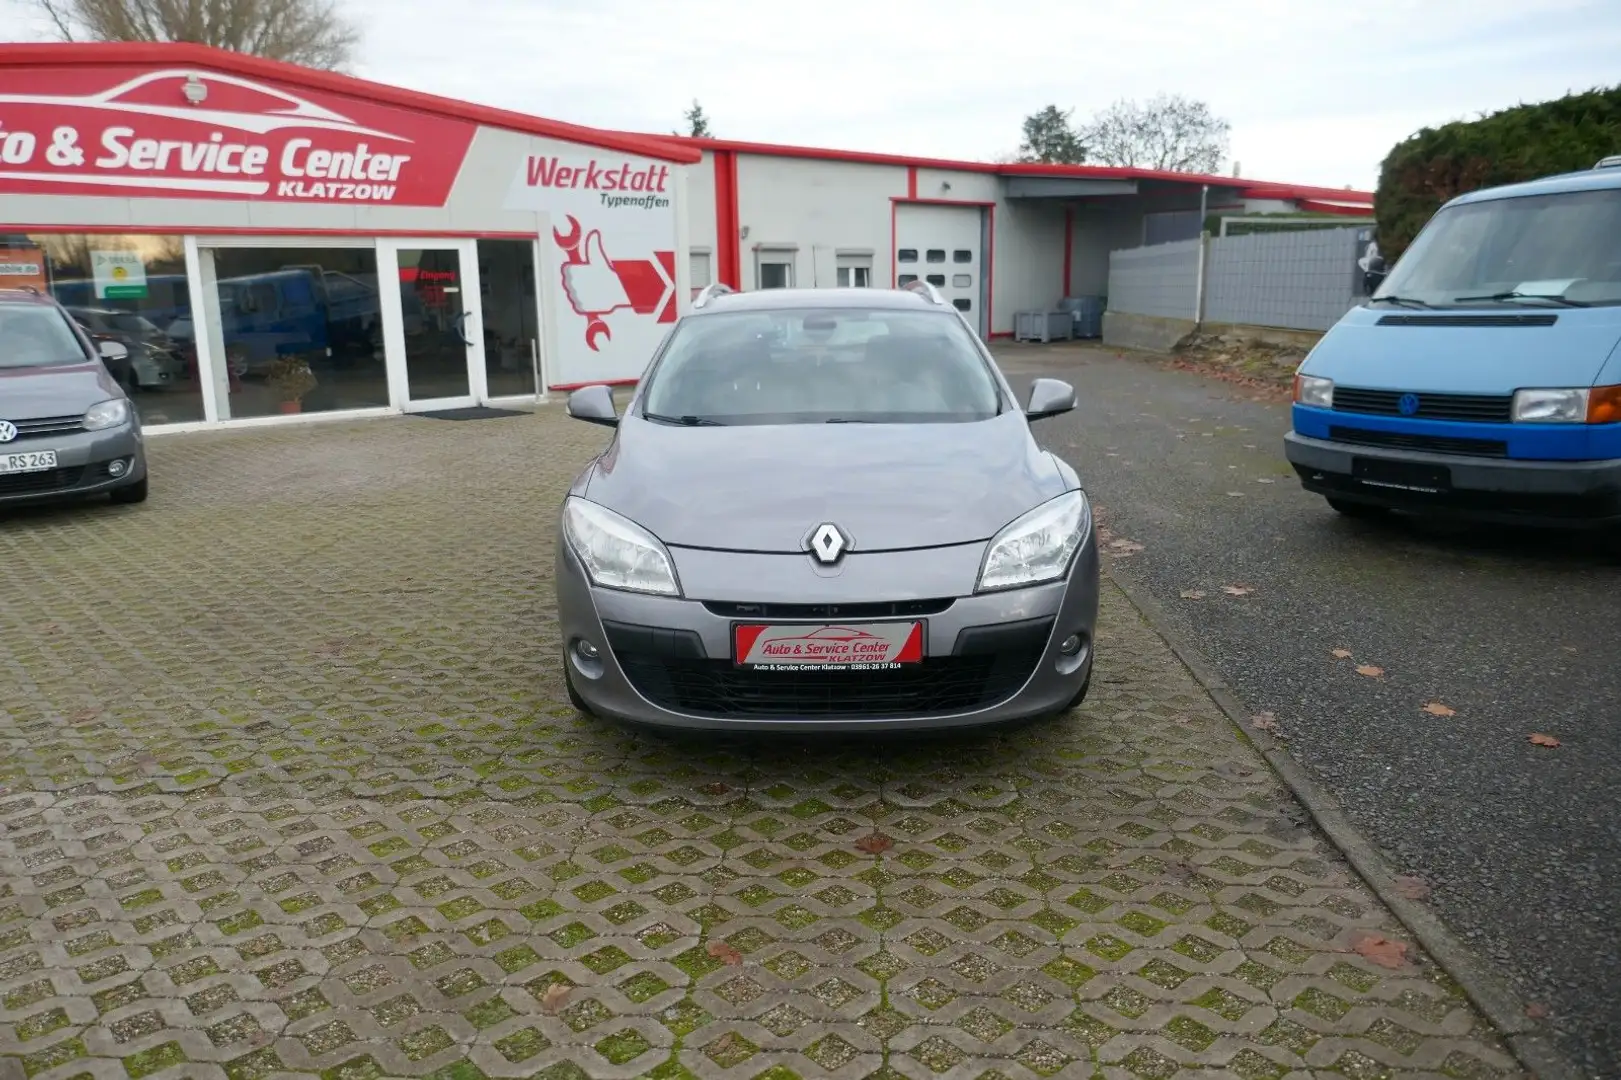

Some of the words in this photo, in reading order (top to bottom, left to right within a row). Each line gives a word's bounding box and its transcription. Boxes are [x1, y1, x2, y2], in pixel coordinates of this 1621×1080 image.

[0, 120, 36, 164] o
[46, 126, 84, 166] &
[95, 127, 269, 175] Service
[280, 138, 411, 181] Center
[527, 156, 668, 192] Werkstatt
[277, 180, 396, 200] KLATZOW
[600, 193, 669, 209] Typenoffen
[8, 455, 27, 469] RS
[30, 452, 55, 466] 263
[763, 643, 791, 655] Auto
[793, 644, 802, 654] &
[805, 643, 849, 654] Service
[853, 641, 891, 653] Center
[828, 654, 886, 662] KLATZOW
